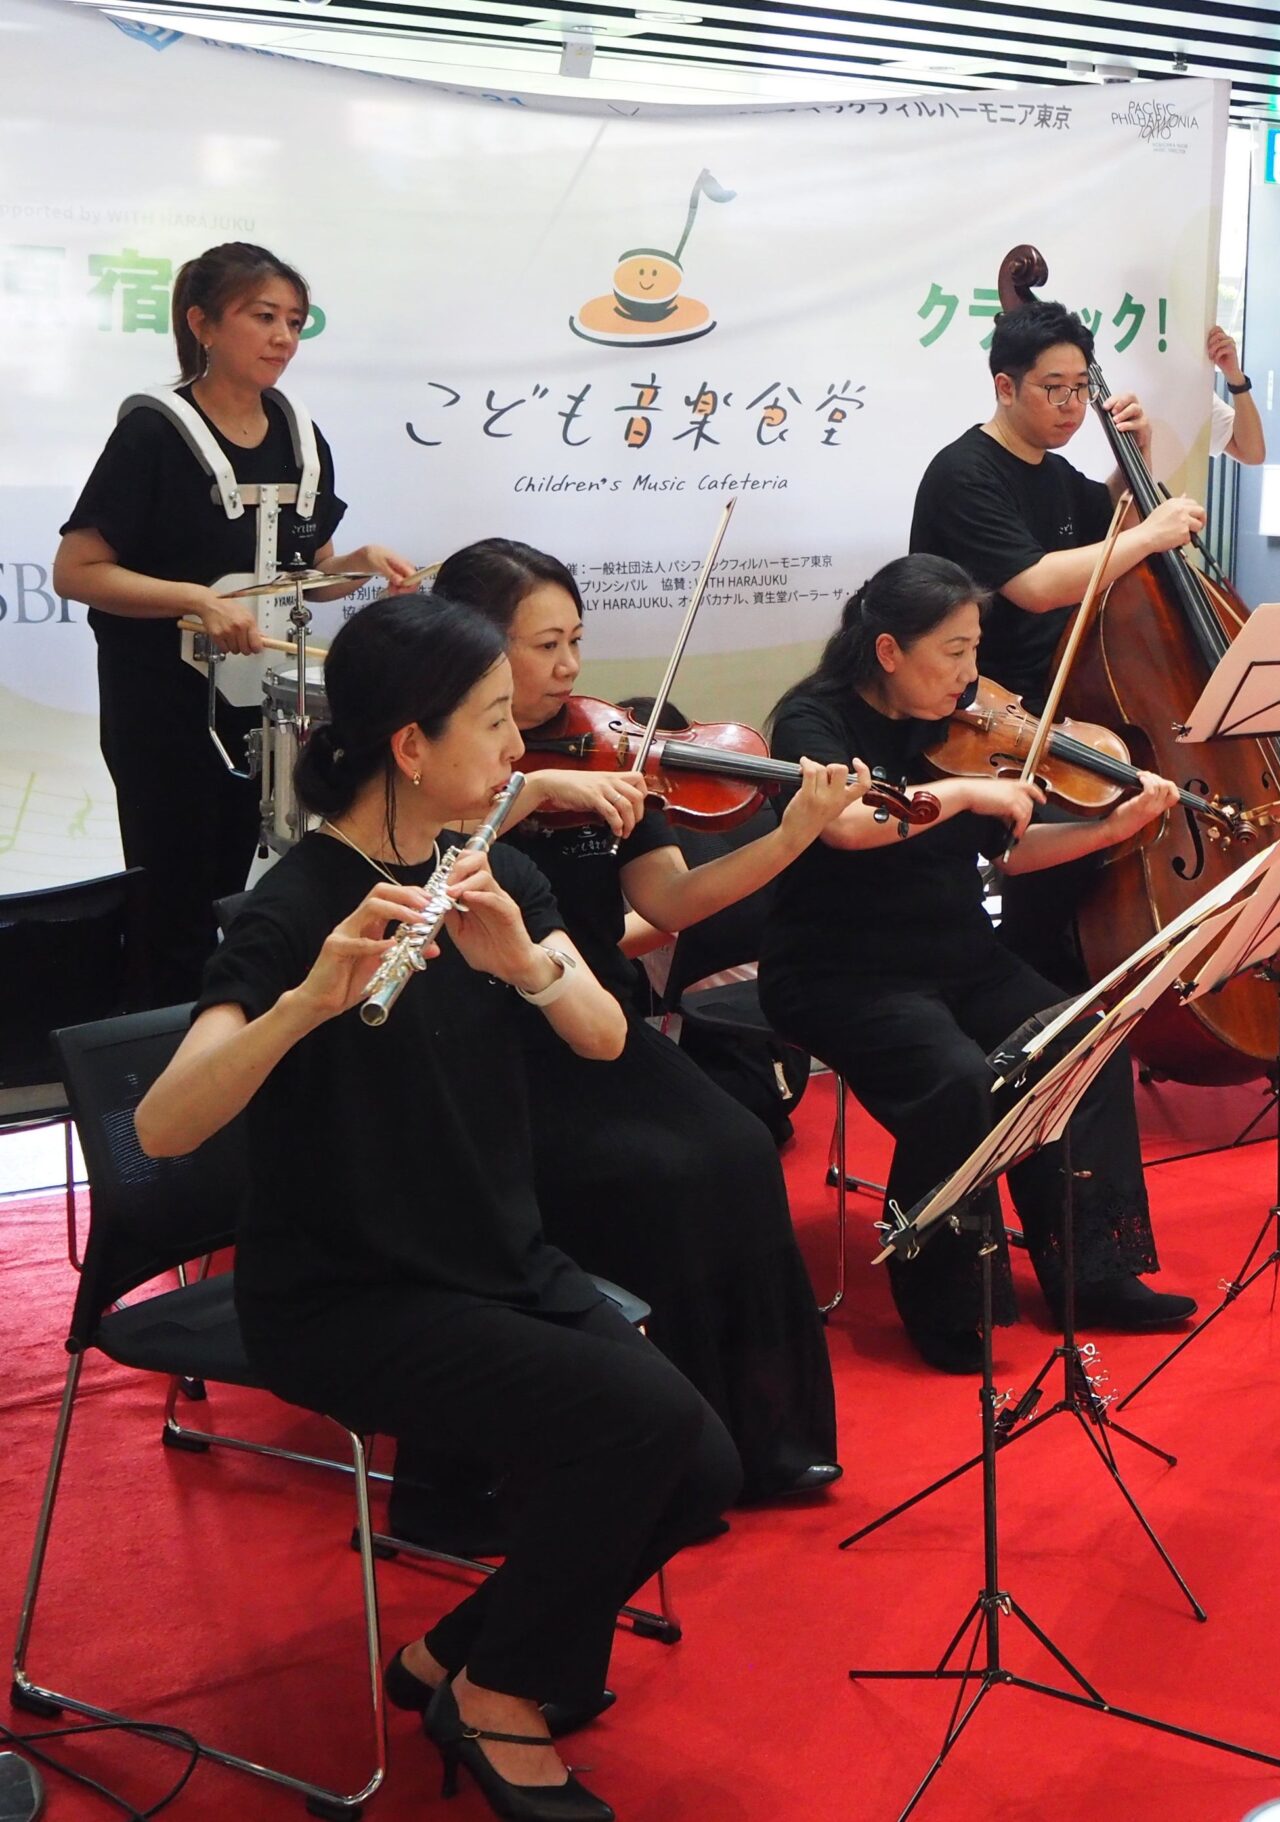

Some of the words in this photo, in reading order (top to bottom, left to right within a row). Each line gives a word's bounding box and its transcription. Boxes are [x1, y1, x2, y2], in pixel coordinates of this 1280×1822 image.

[405, 373, 866, 451] こども音楽食堂
[514, 474, 623, 493] Children's
[633, 474, 687, 492] Music
[697, 472, 789, 492] Cafeteria
[728, 574, 787, 588] HARAJUKU
